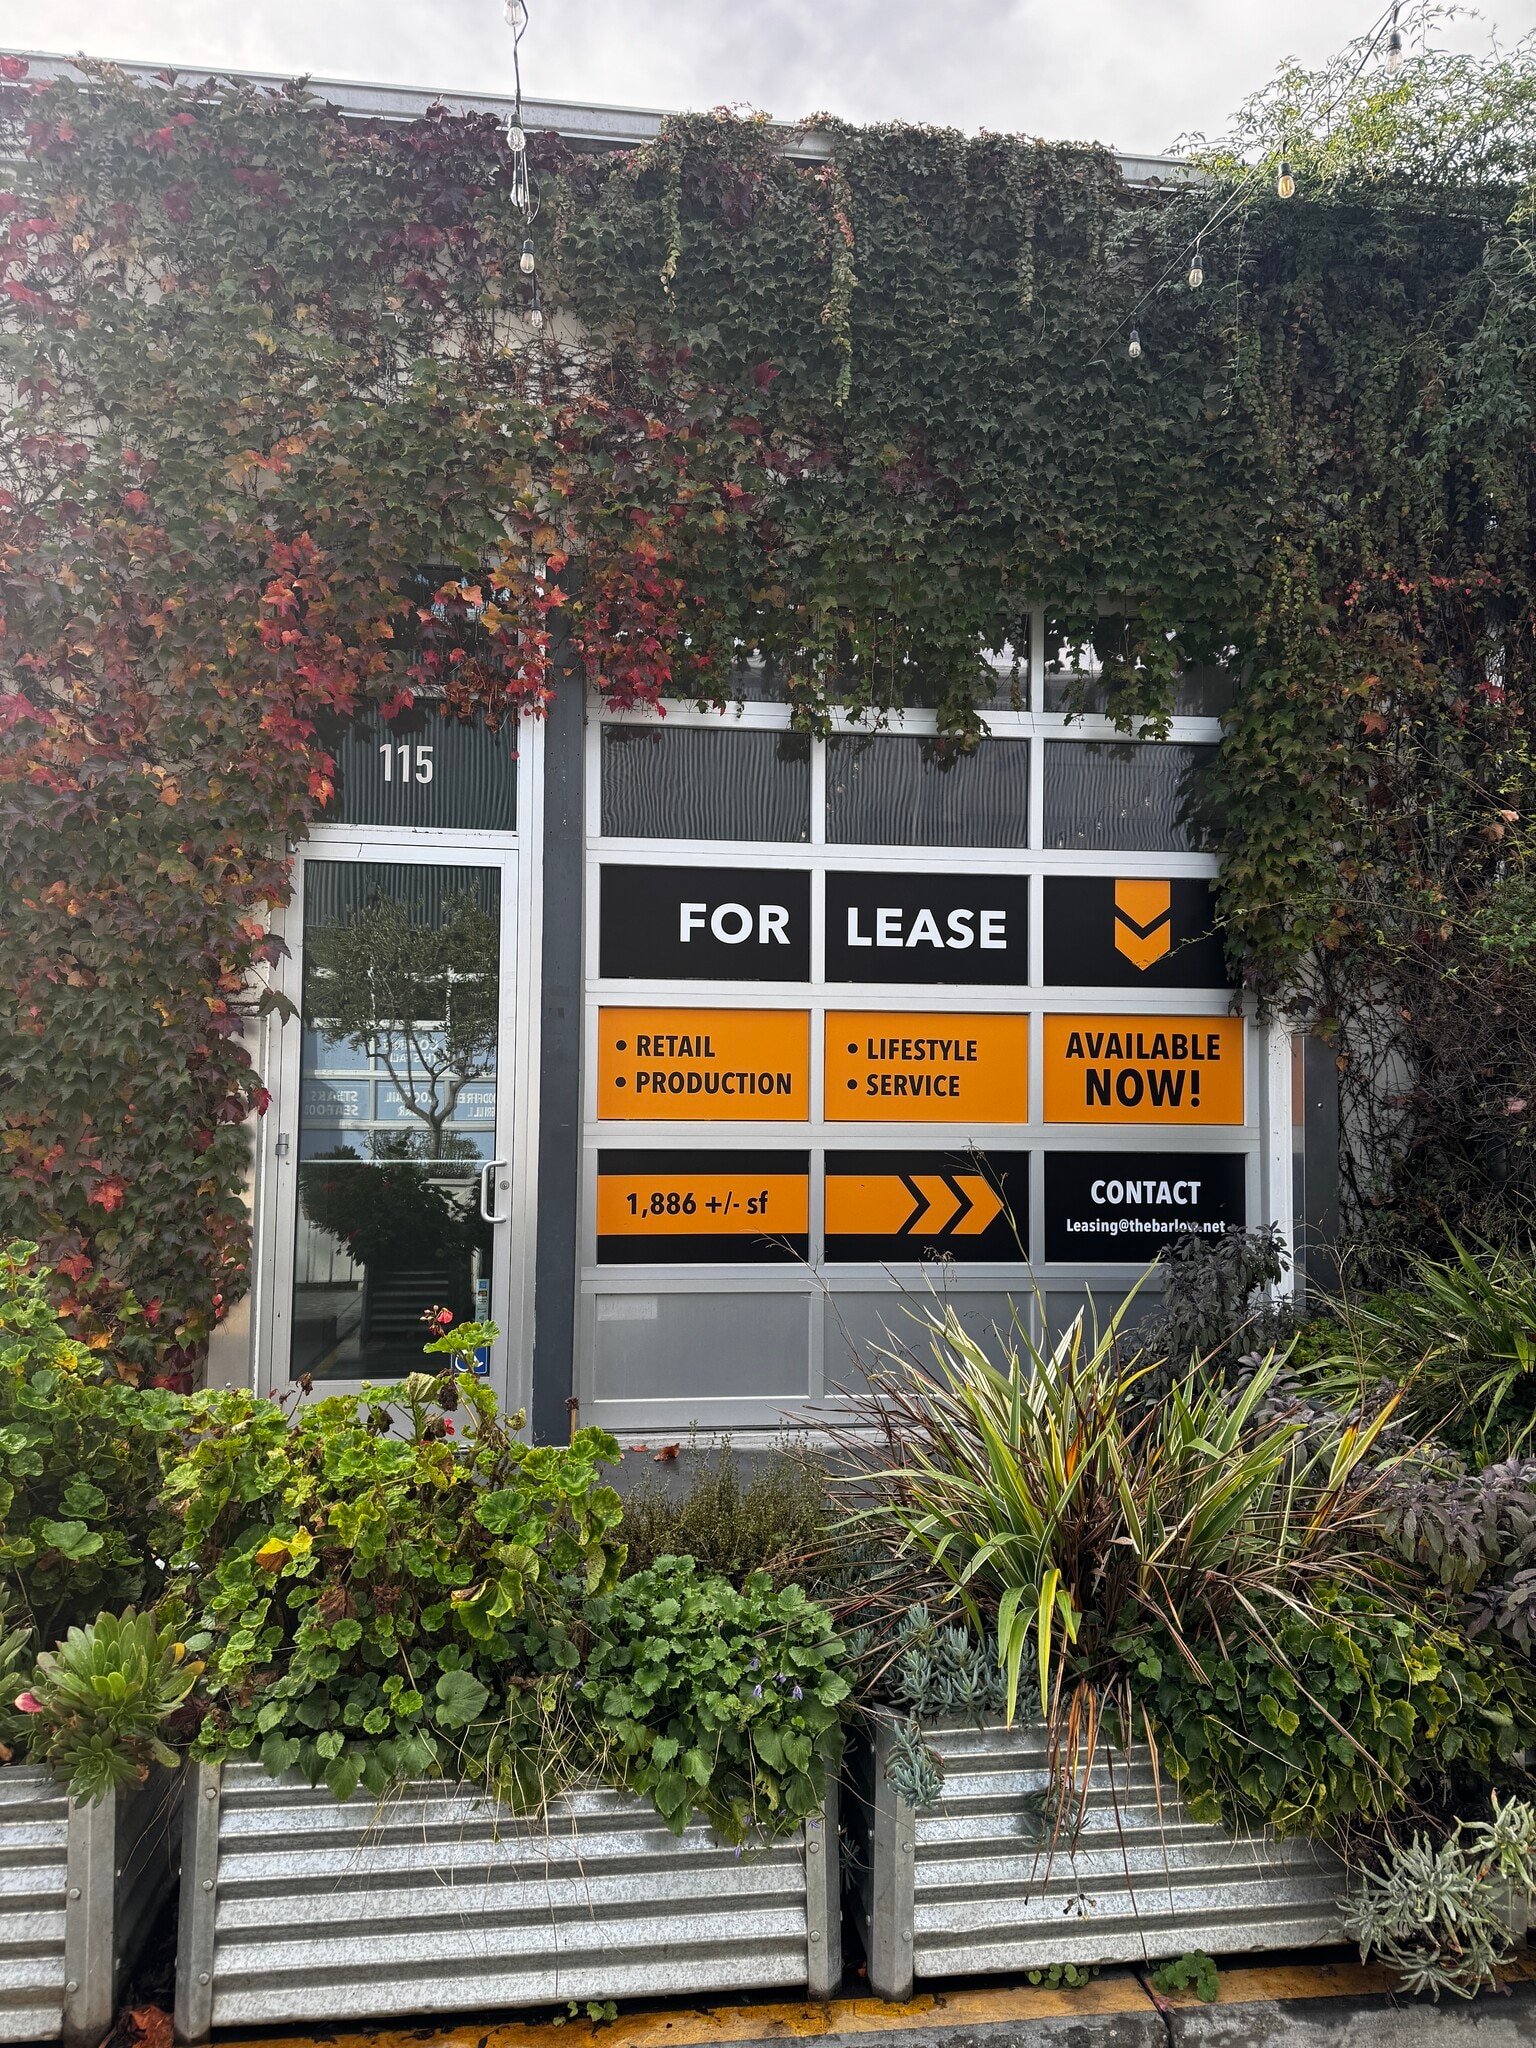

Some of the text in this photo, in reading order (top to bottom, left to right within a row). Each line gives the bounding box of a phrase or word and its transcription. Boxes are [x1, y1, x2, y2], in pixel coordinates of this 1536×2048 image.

[380, 744, 433, 783] 115
[680, 903, 1007, 948] FOR LEASE
[637, 1035, 716, 1057] RETAIL
[867, 1039, 978, 1061] LIFESTYLE
[1066, 1033, 1221, 1060] AVAILABLE
[637, 1072, 792, 1094] PRODUCTION
[867, 1074, 960, 1096] SERVICE
[1087, 1069, 1200, 1107] NOW!
[627, 1190, 769, 1218] 1,886 +/- sf
[1091, 1180, 1202, 1205] CONTACT
